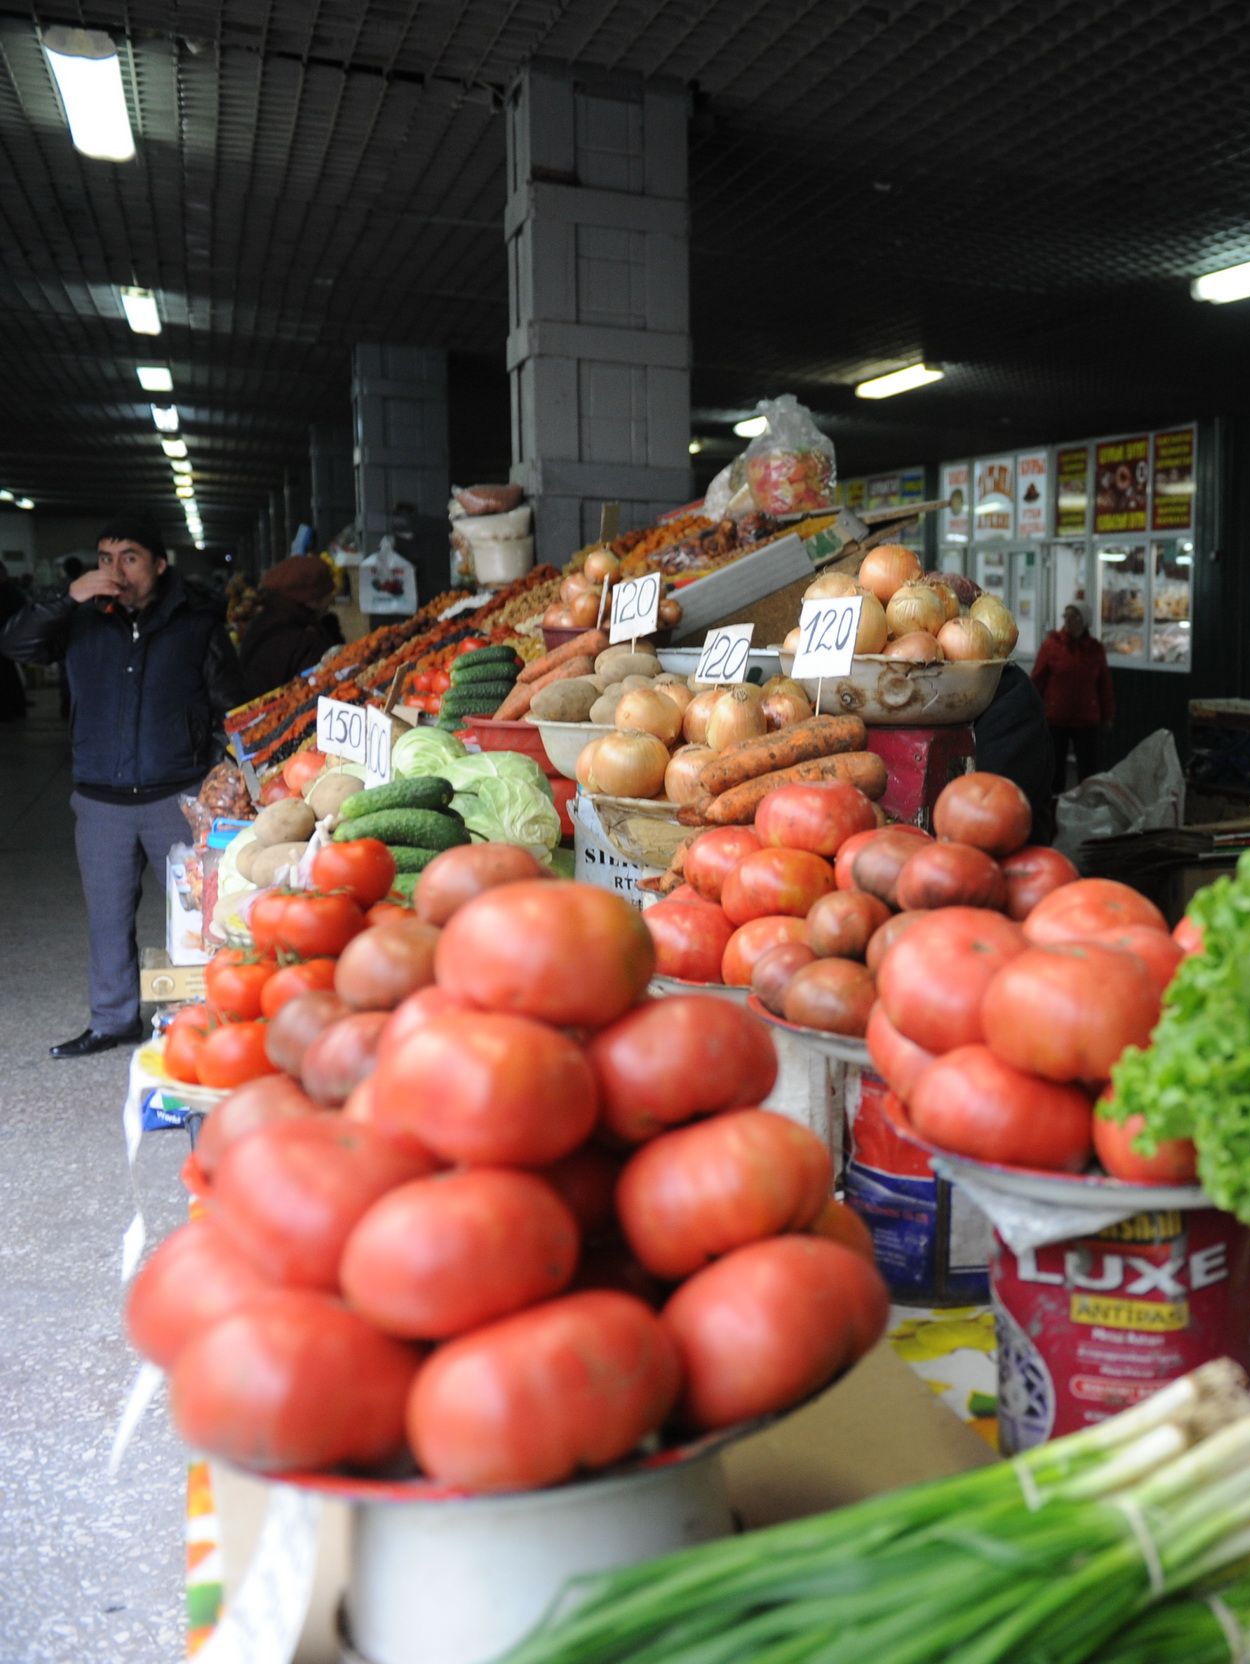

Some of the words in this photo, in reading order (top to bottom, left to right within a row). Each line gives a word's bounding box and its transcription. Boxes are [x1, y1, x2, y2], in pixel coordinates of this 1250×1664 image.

[613, 577, 657, 625] 120
[804, 607, 854, 655] 120
[698, 632, 751, 680] 120
[324, 707, 362, 748] 150
[615, 876, 638, 891] RT
[1017, 1243, 1229, 1297] LUXE
